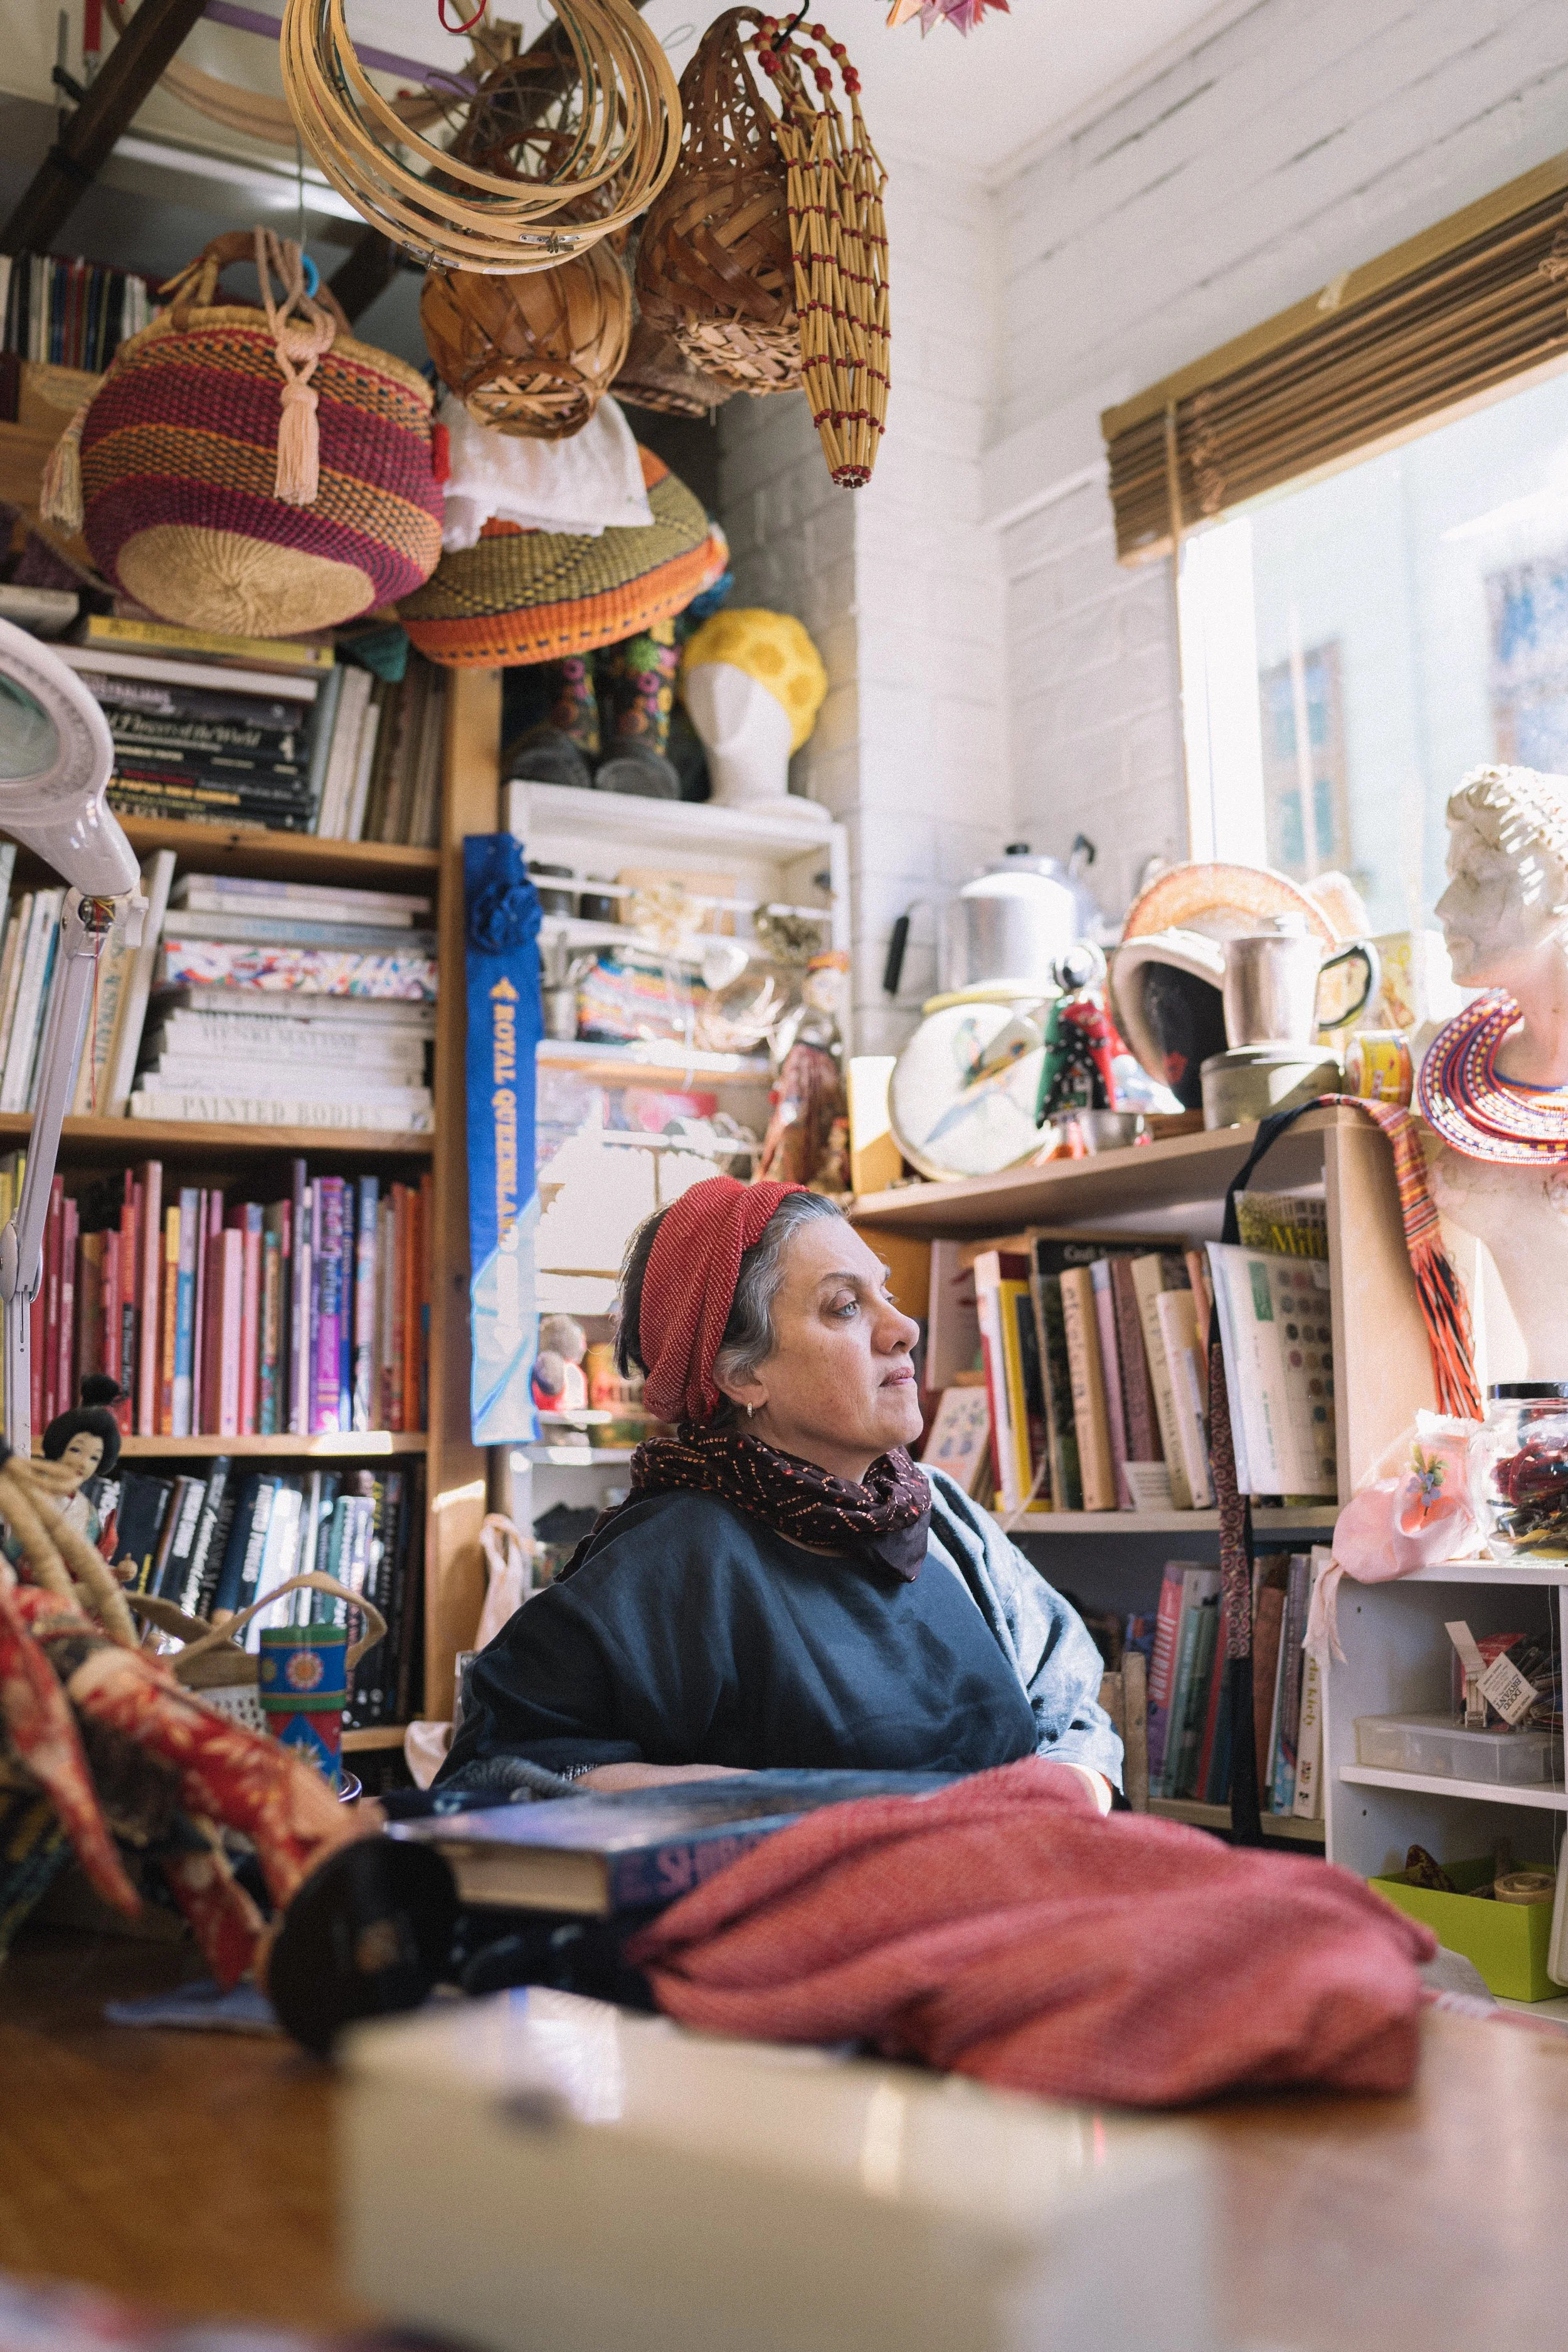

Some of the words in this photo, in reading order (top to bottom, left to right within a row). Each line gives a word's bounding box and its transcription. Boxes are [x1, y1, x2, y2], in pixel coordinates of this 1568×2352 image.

[493, 1003, 517, 1085] ROYAL
[182, 1095, 285, 1124] PAINTED
[1496, 1677, 1522, 1710] BRYANT
[1504, 1688, 1522, 1711] DOUG
